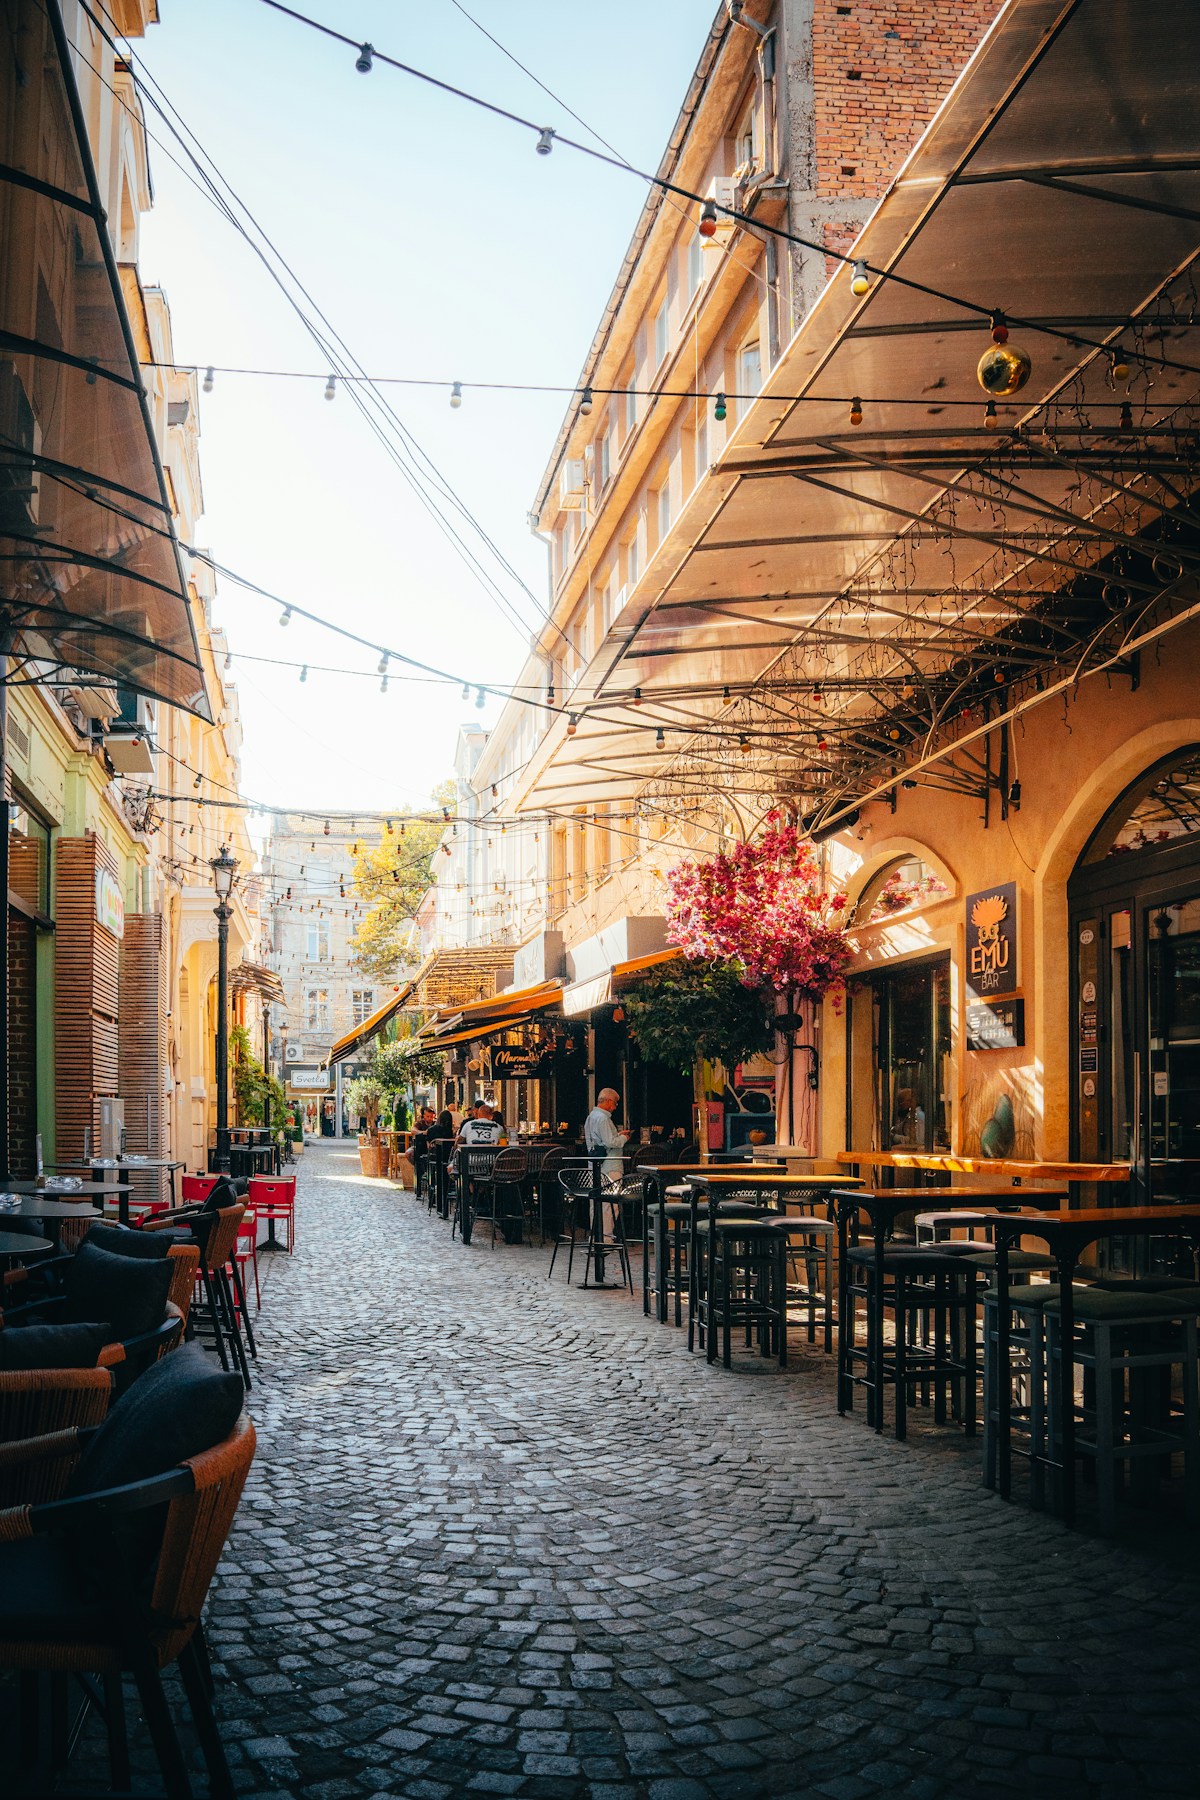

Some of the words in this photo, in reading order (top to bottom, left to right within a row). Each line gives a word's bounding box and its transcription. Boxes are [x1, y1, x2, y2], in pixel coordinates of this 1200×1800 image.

[971, 935, 1008, 973] EMÚ
[981, 972, 999, 990] BAR
[296, 1075, 325, 1083] Svetla
[476, 1131, 492, 1139] Y-3
